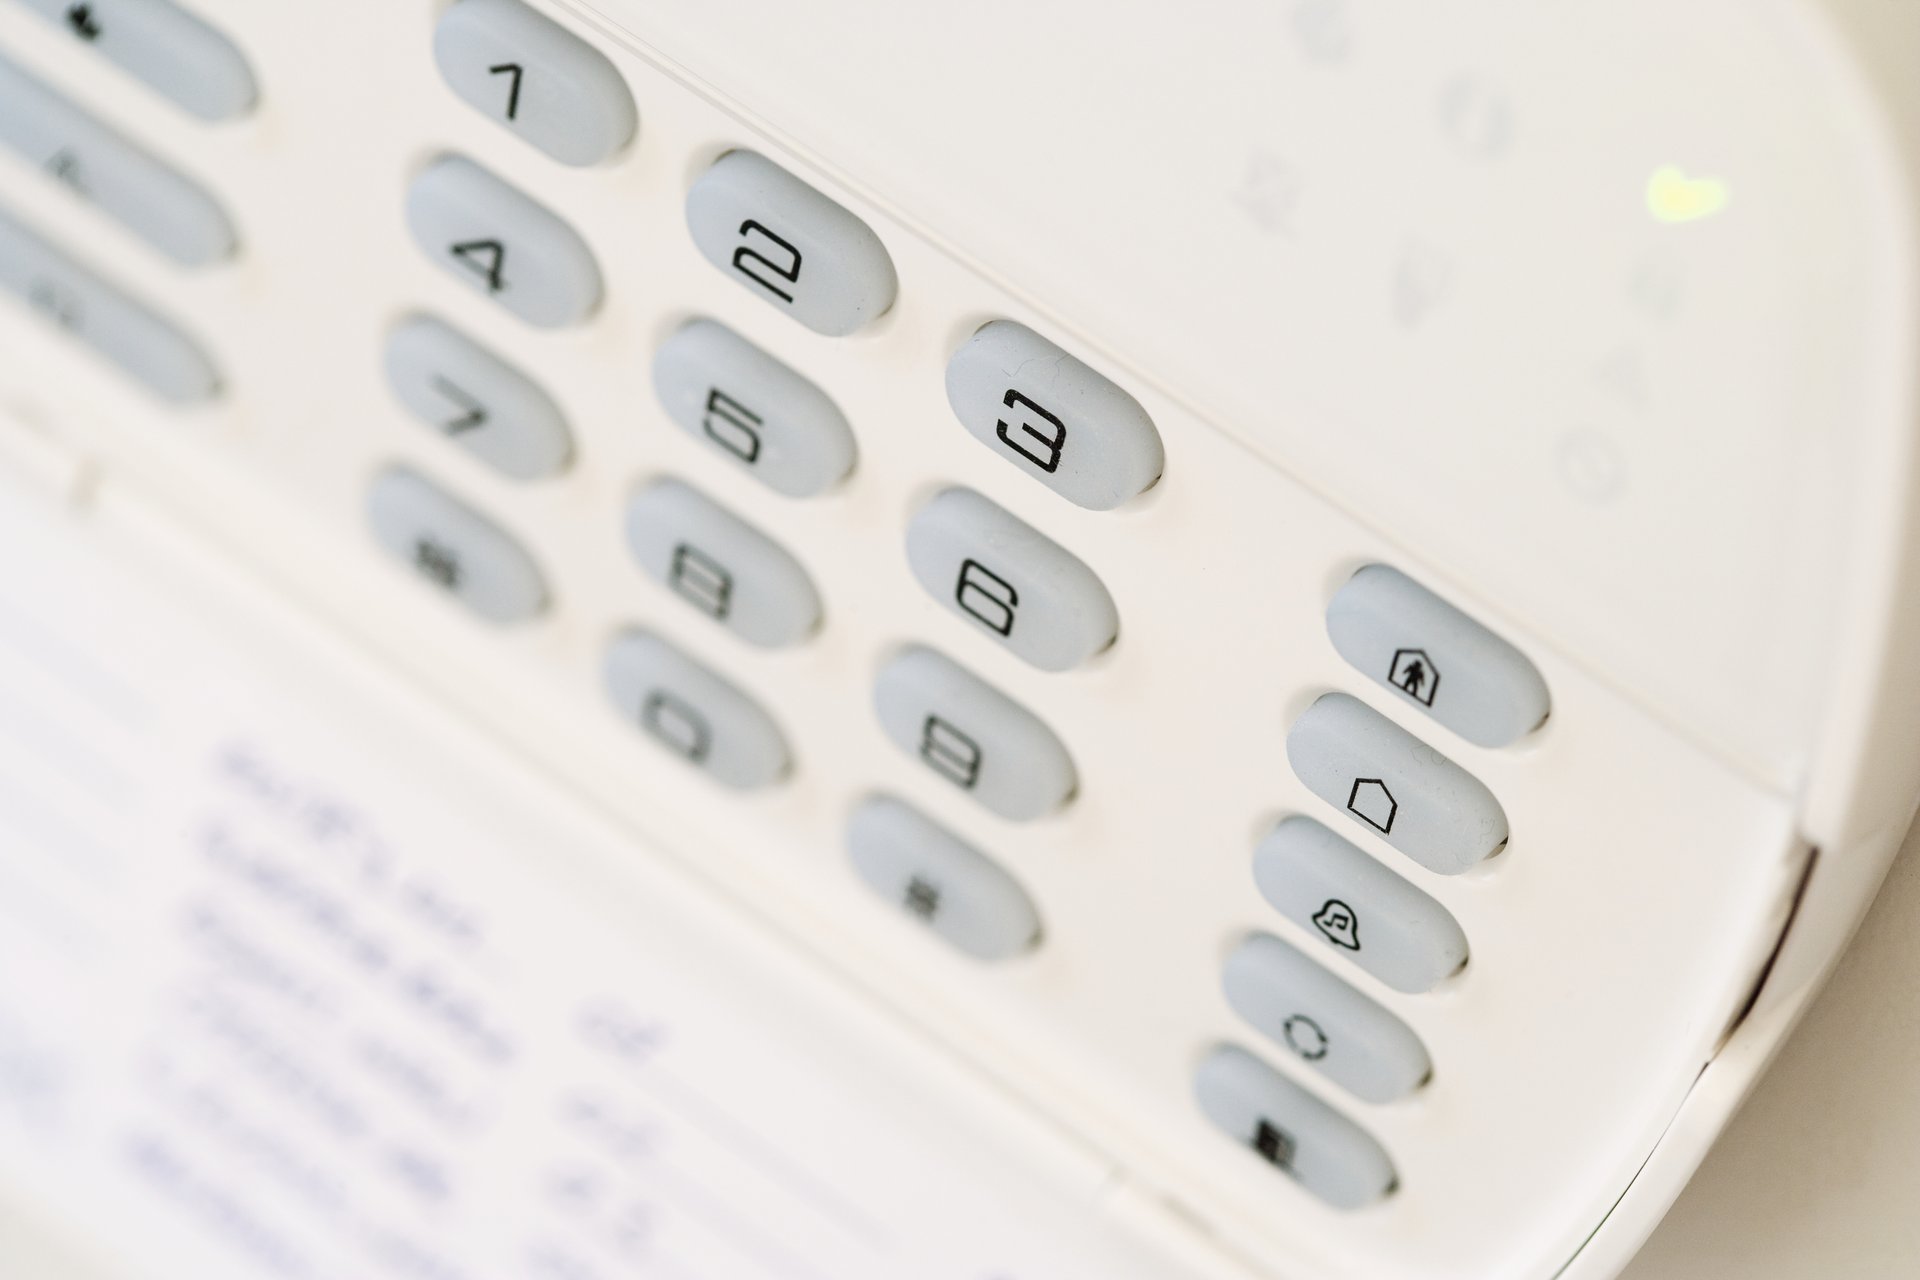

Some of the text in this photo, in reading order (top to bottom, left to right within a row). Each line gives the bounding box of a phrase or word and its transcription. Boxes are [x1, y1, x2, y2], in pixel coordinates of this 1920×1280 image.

[488, 62, 523, 121] 1
[450, 238, 507, 293] 4
[732, 219, 803, 303] 2
[431, 374, 489, 437] 7
[702, 386, 763, 465] 5
[995, 388, 1067, 474] 3
[668, 541, 734, 622] 8
[955, 557, 1019, 638] 6
[642, 690, 713, 765] 0
[919, 713, 983, 791] 9
